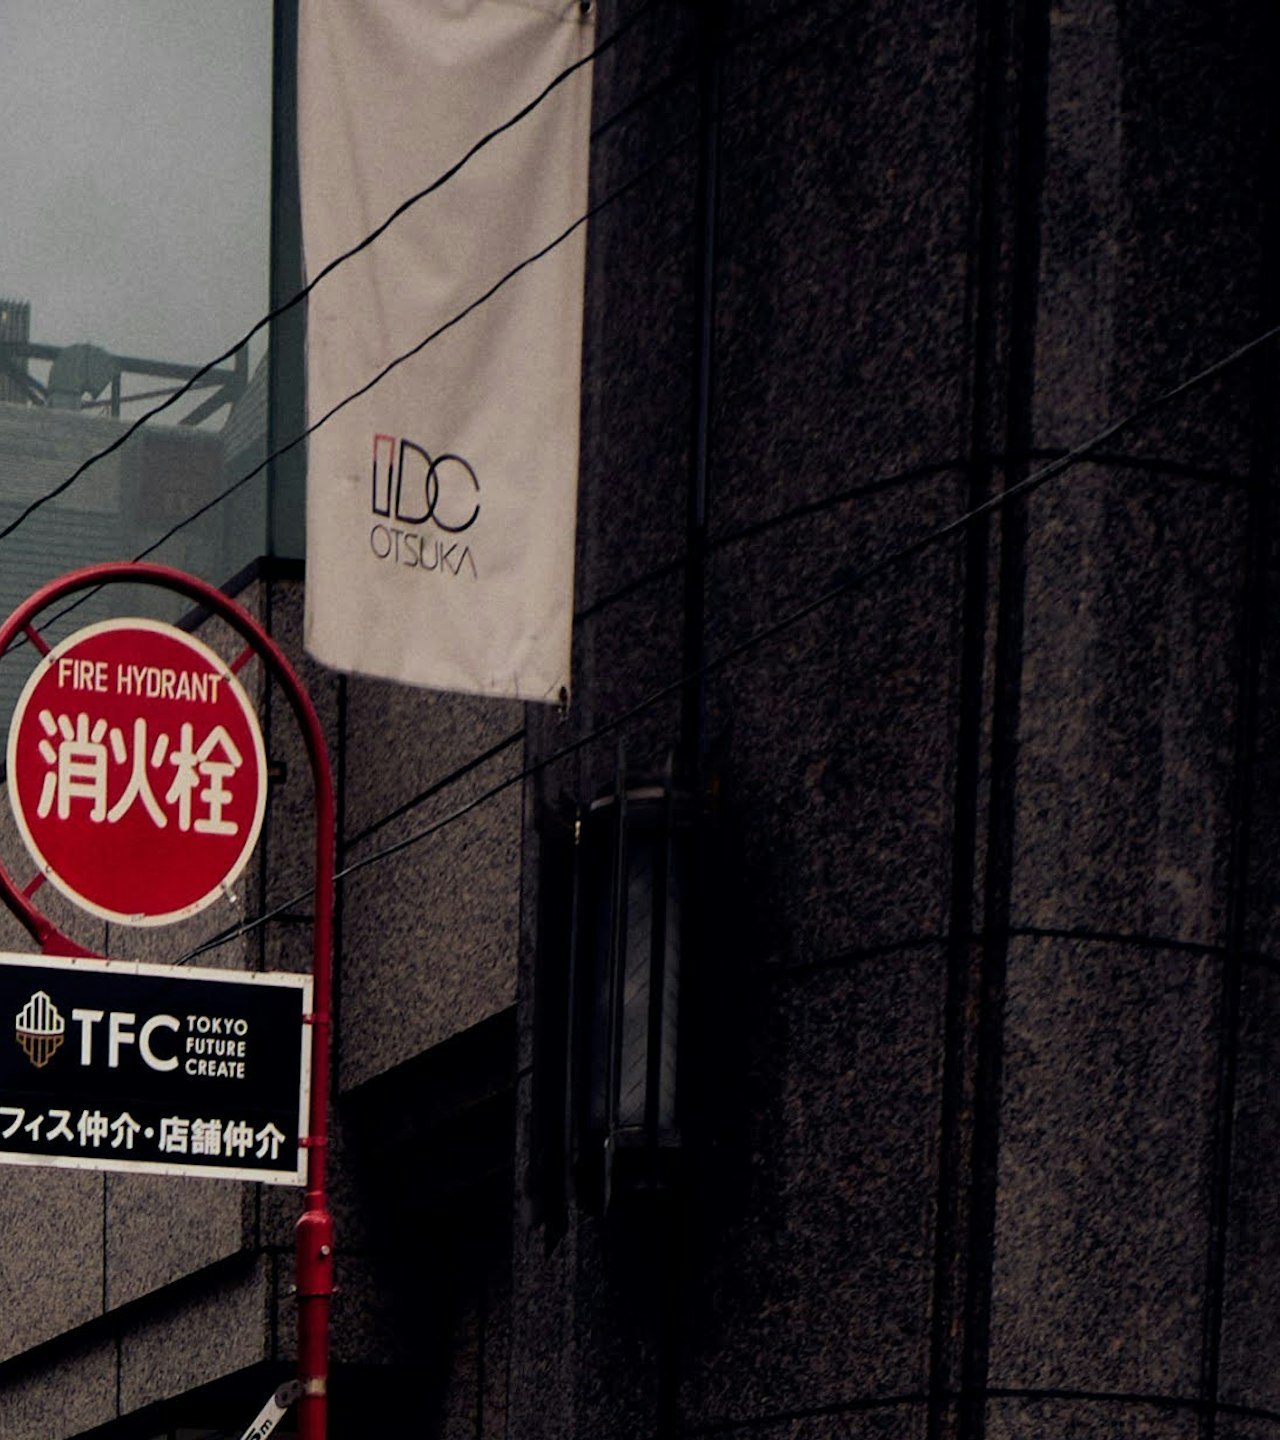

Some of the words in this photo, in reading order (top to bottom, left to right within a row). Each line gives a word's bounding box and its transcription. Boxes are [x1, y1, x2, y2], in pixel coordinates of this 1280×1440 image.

[372, 433, 481, 533] IDC
[370, 524, 478, 580] OTSUKA
[58, 658, 108, 692] FIRE
[117, 664, 223, 704] HYDRANT
[37, 709, 243, 836] 消火栓
[72, 1008, 180, 1072] TFC
[186, 1037, 246, 1058] FUTURE
[187, 1015, 248, 1036] TOKYO
[185, 1058, 245, 1079] CREATE
